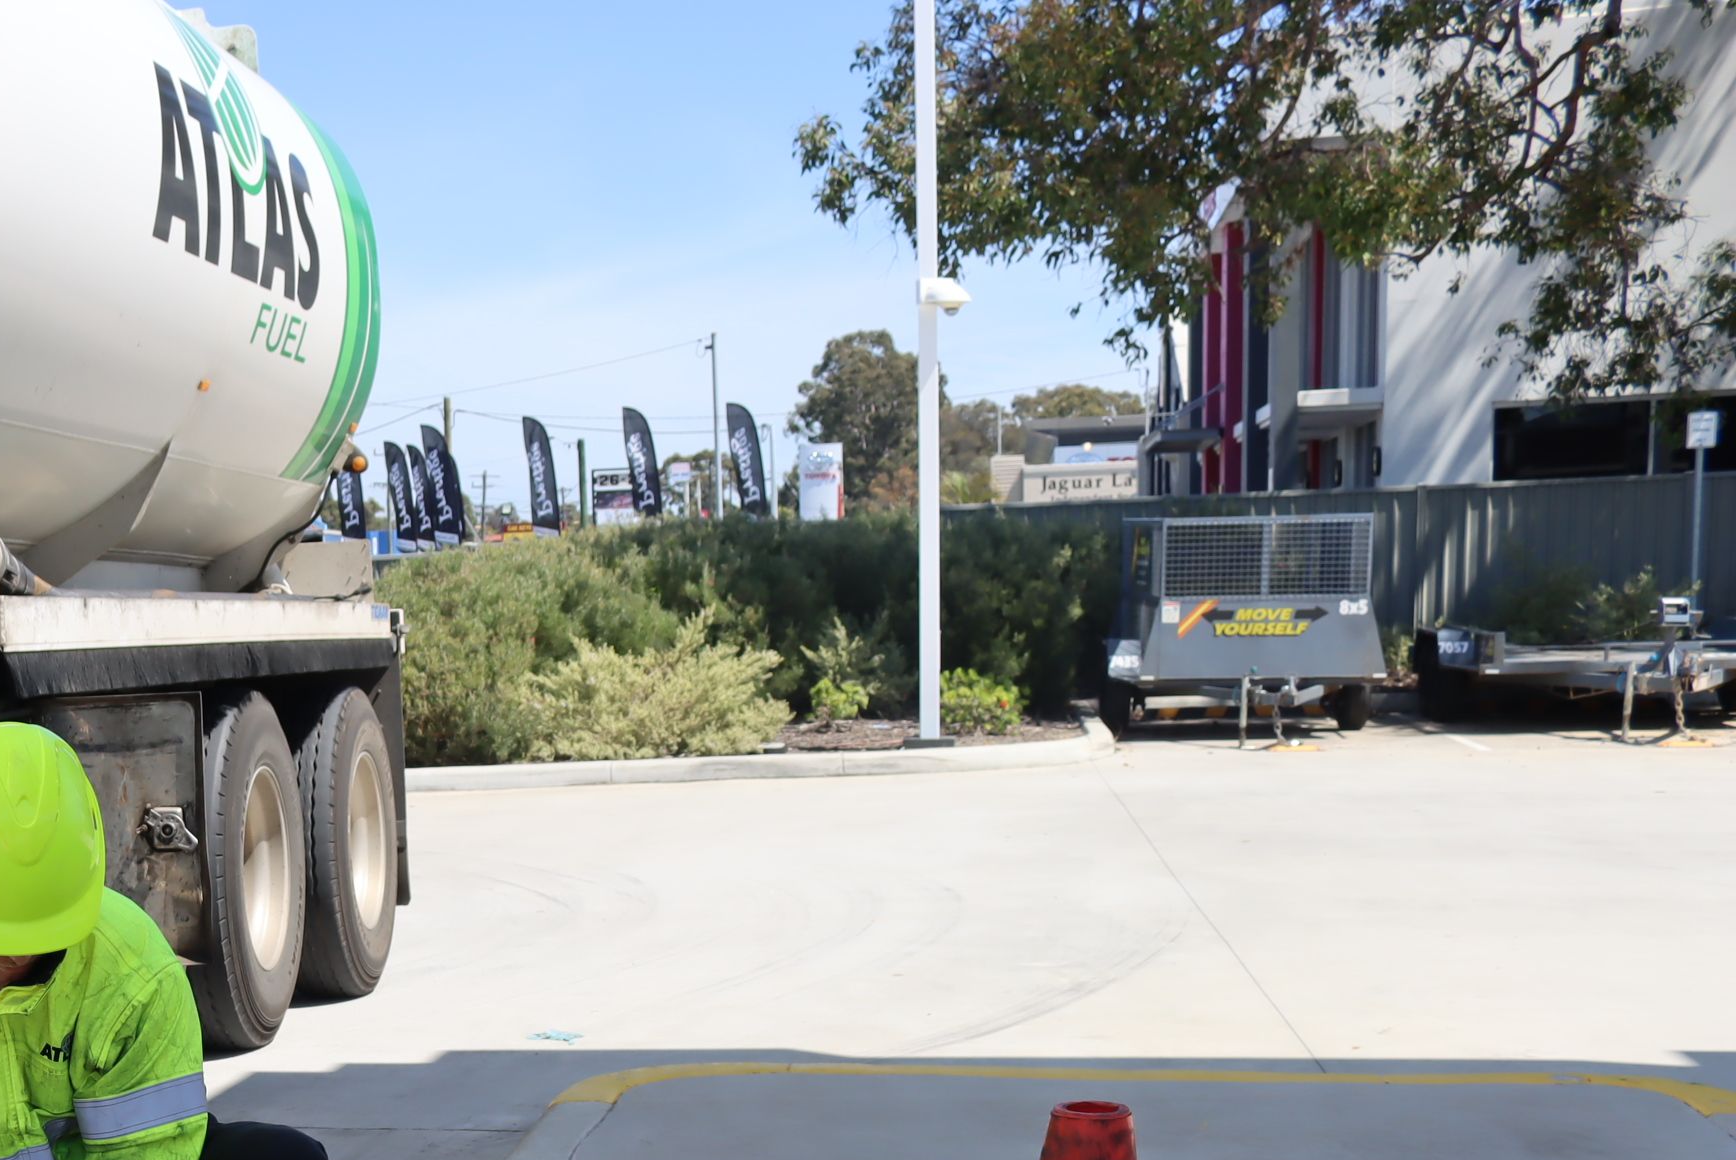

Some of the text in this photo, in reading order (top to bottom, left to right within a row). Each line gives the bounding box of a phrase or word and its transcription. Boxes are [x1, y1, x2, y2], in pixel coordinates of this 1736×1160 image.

[152, 60, 320, 311] ATLAS
[250, 302, 307, 364] FUEL
[1040, 473, 1133, 495] Jaguar La
[1236, 607, 1294, 621] MOVE
[1339, 599, 1368, 615] 8x5
[1214, 622, 1309, 636] YOURSELF
[1438, 641, 1469, 654] 7057
